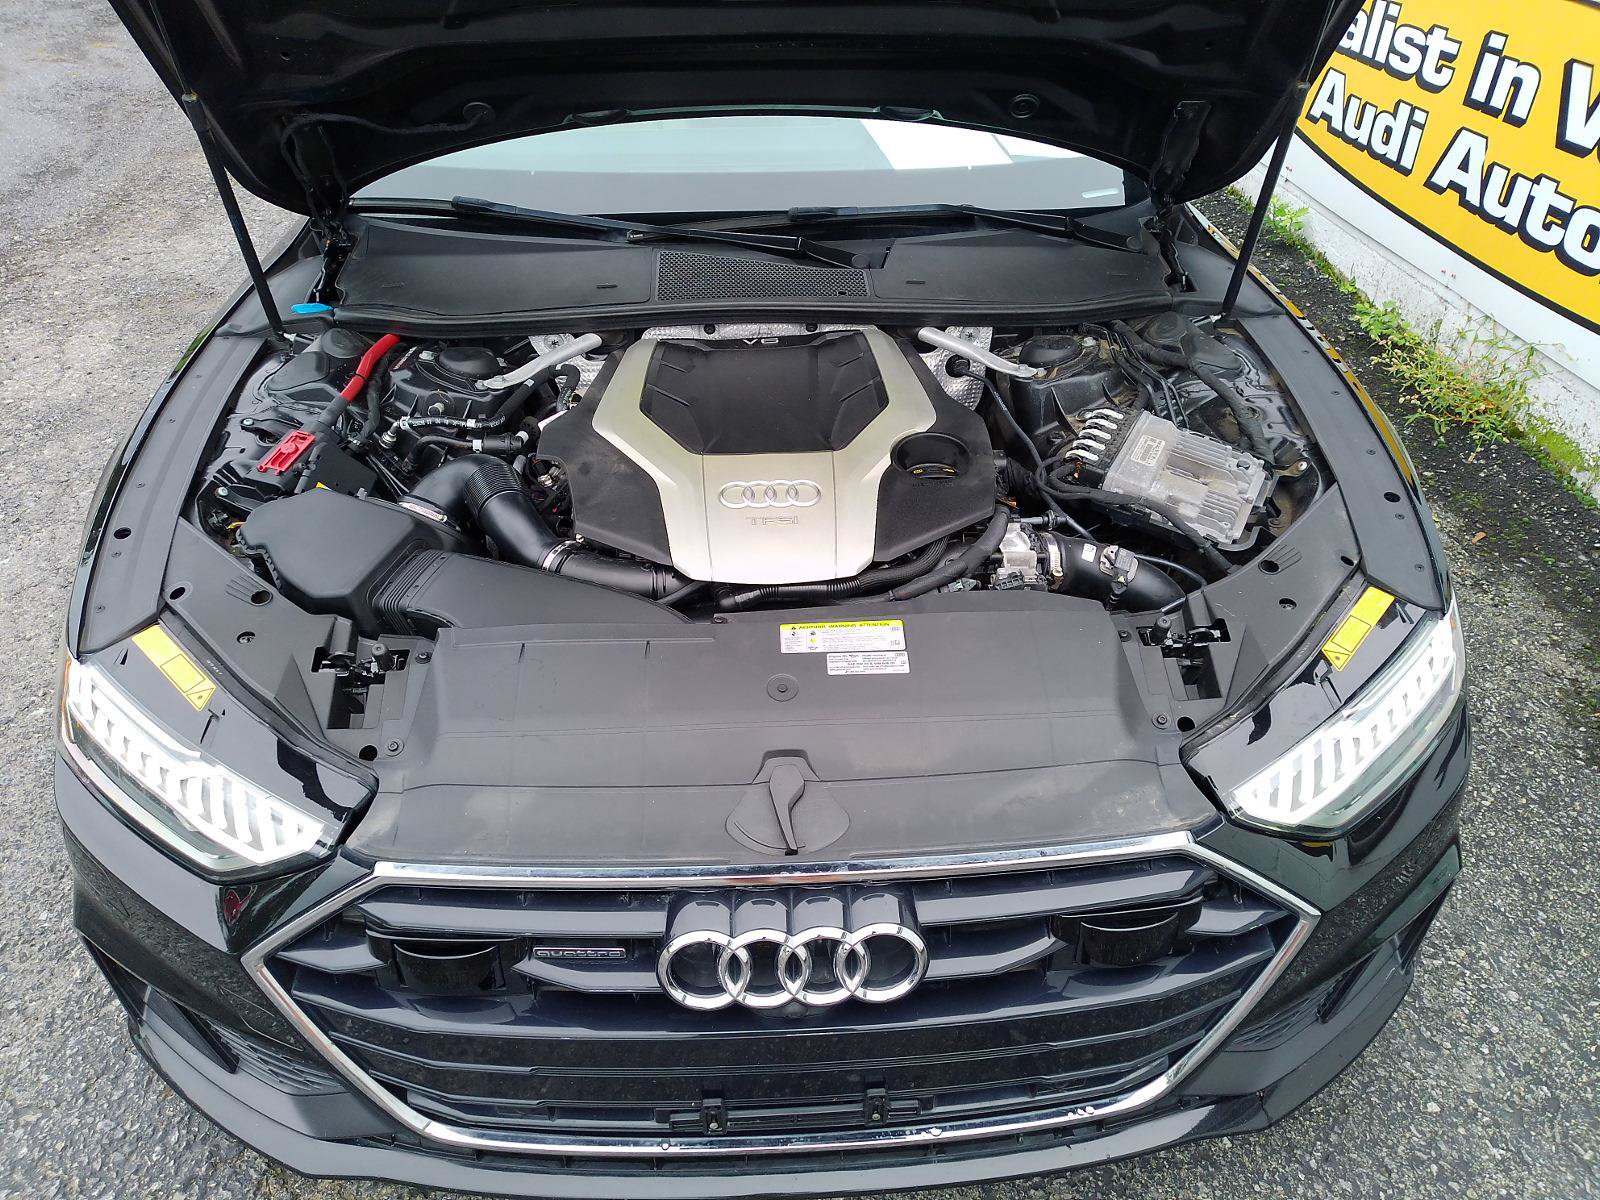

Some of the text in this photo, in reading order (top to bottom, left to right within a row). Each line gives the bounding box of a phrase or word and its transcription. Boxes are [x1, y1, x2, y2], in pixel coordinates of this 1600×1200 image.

[1464, 31, 1541, 126] in
[1306, 68, 1600, 275] Audi Auto
[746, 516, 799, 525] TFSI
[536, 950, 621, 958] quattro
